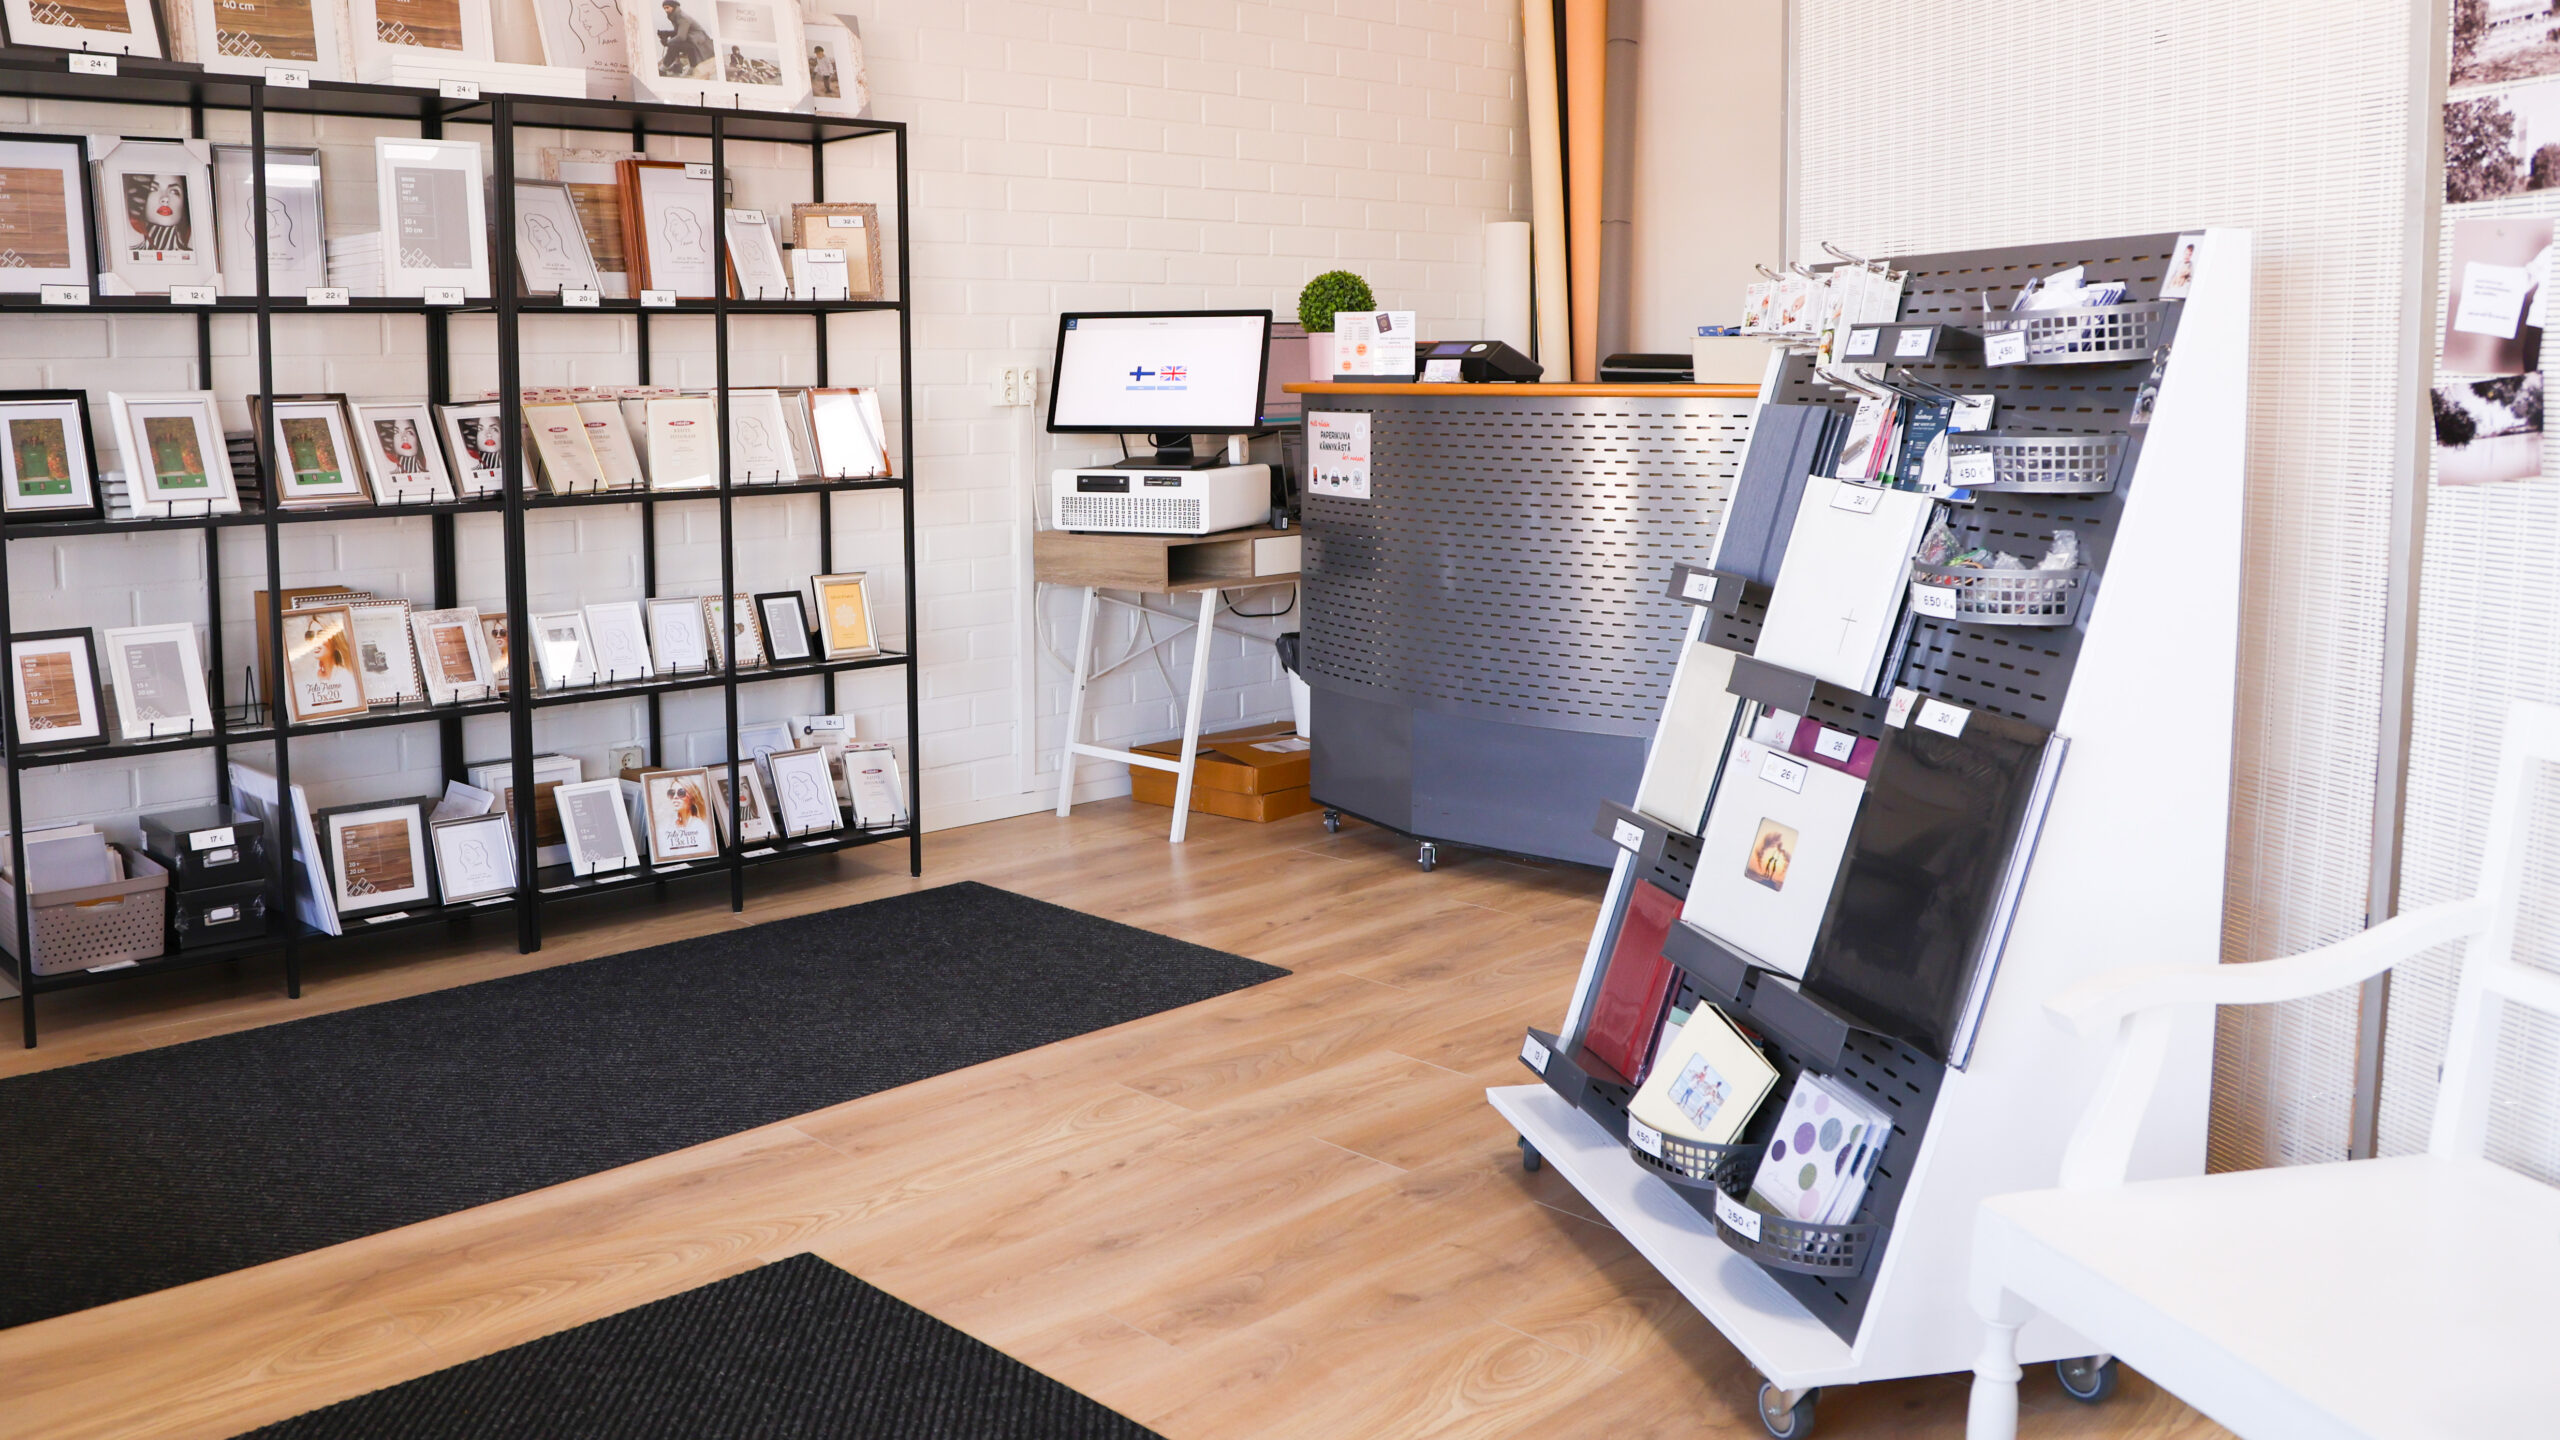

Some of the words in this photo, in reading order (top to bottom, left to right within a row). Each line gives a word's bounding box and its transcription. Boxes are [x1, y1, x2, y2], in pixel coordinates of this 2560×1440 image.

[239, 2, 255, 11] cm
[63, 292, 72, 300] 16
[442, 291, 449, 299] 10
[311, 690, 340, 702] 15x20
[1938, 712, 1949, 723] 30
[1780, 768, 1791, 780] 26
[210, 835, 217, 843] 17
